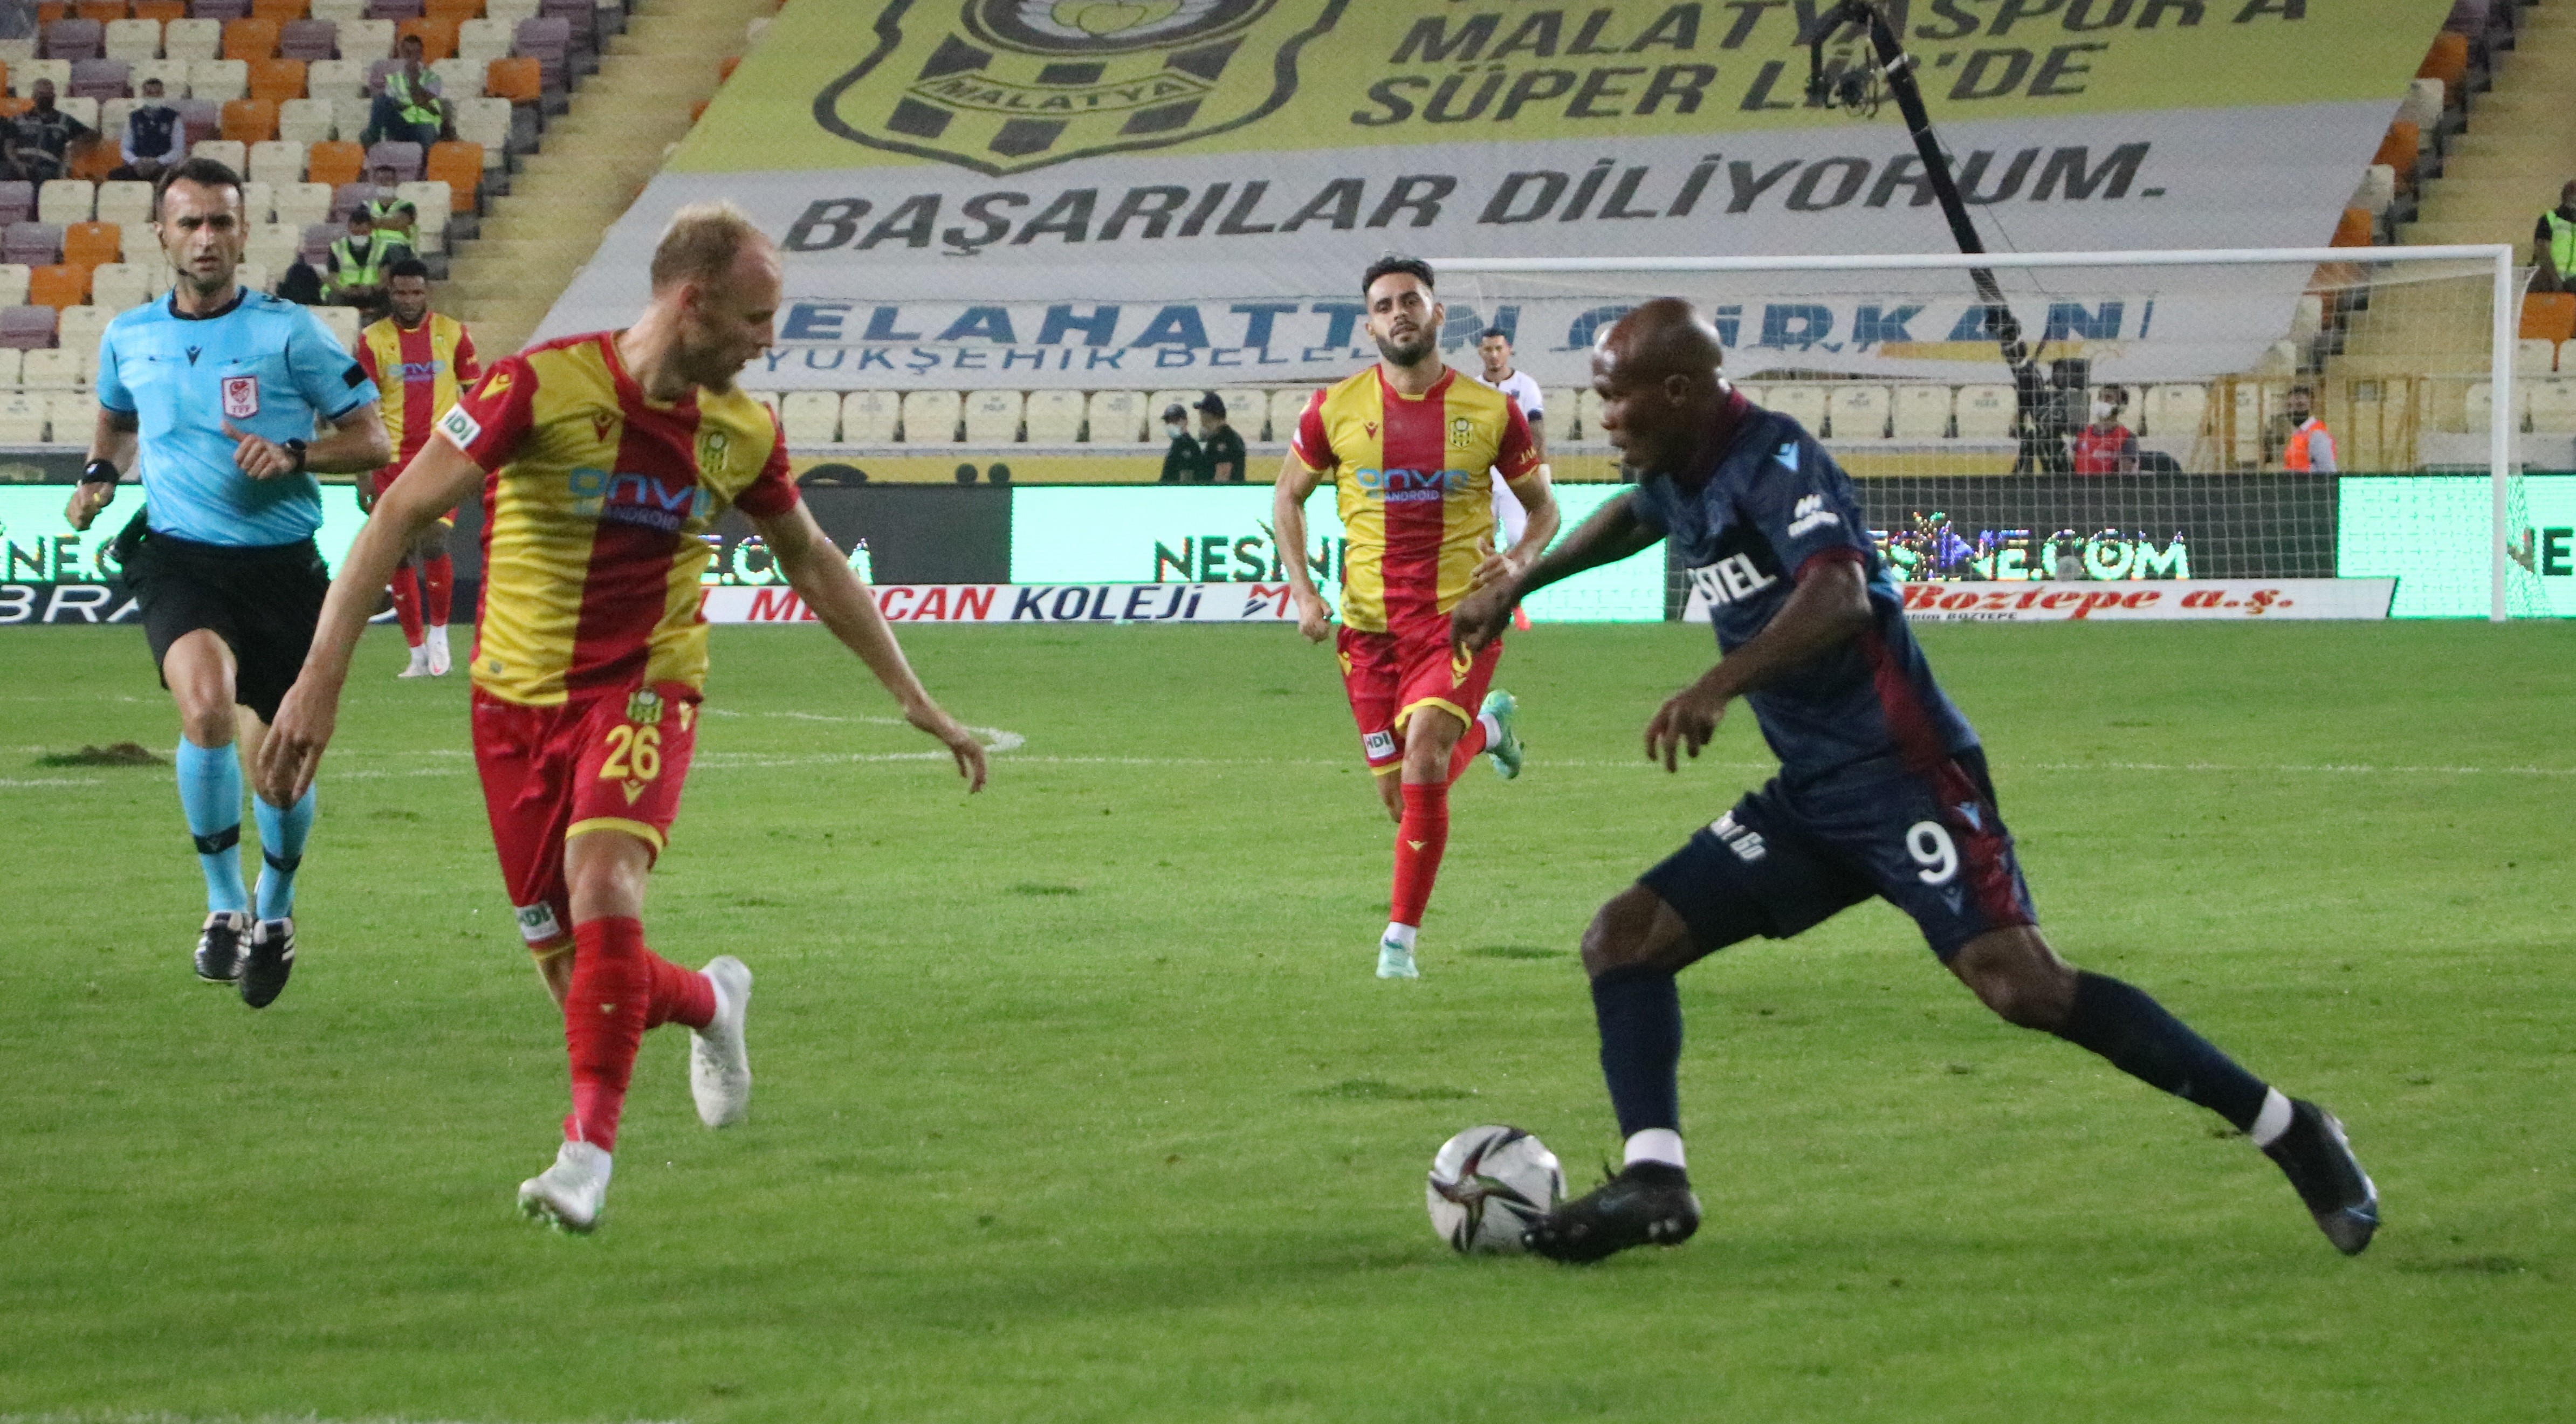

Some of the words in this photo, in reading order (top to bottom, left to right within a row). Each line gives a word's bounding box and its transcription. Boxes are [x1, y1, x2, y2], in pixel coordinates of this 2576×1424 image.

[933, 79, 1189, 109] MALATYA
[1350, 63, 1717, 126] SÜPER
[781, 174, 1458, 256] BAŞARILAR
[1478, 142, 2165, 224] DİLİYORUM.
[780, 303, 1520, 354] ELAHATTN
[1687, 552, 1778, 606] STEL
[1904, 584, 2161, 619] Boztepe
[599, 724, 661, 780] 26
[1905, 820, 1958, 885] 9
